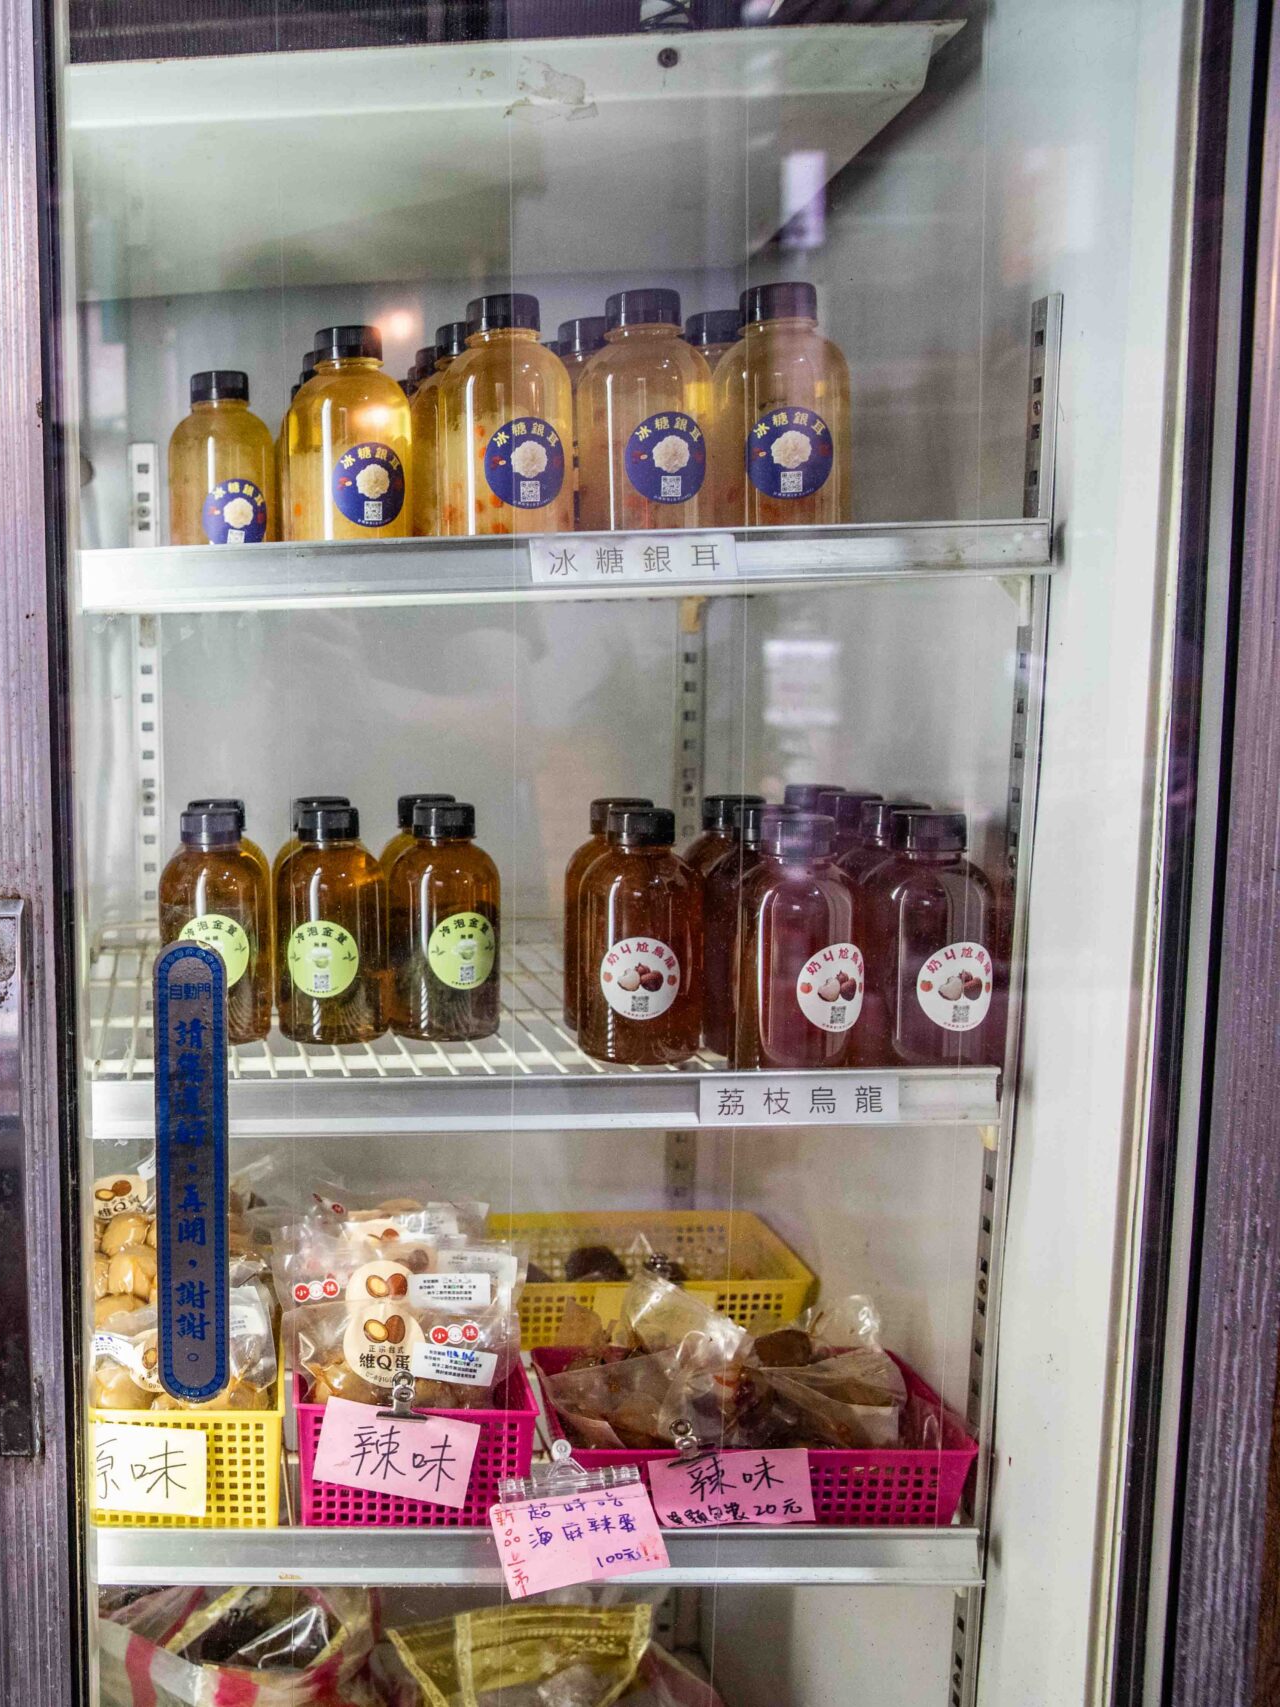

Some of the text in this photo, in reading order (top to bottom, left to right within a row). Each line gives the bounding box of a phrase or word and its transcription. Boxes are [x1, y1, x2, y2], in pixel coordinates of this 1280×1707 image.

[492, 421, 560, 448] 冰糖銀耳
[634, 416, 702, 443] 冰糖銀耳
[753, 411, 826, 439] 冰糖銀耳
[340, 446, 400, 471] 冰糖銀耳
[549, 543, 721, 577] 冰糖銀耳
[717, 1085, 883, 1117] 荔枝烏龍
[359, 1353, 411, 1372] 維Q蛋
[350, 1425, 457, 1492] 辣味
[686, 1456, 784, 1502] 辣味
[493, 1509, 529, 1596] 新品上市
